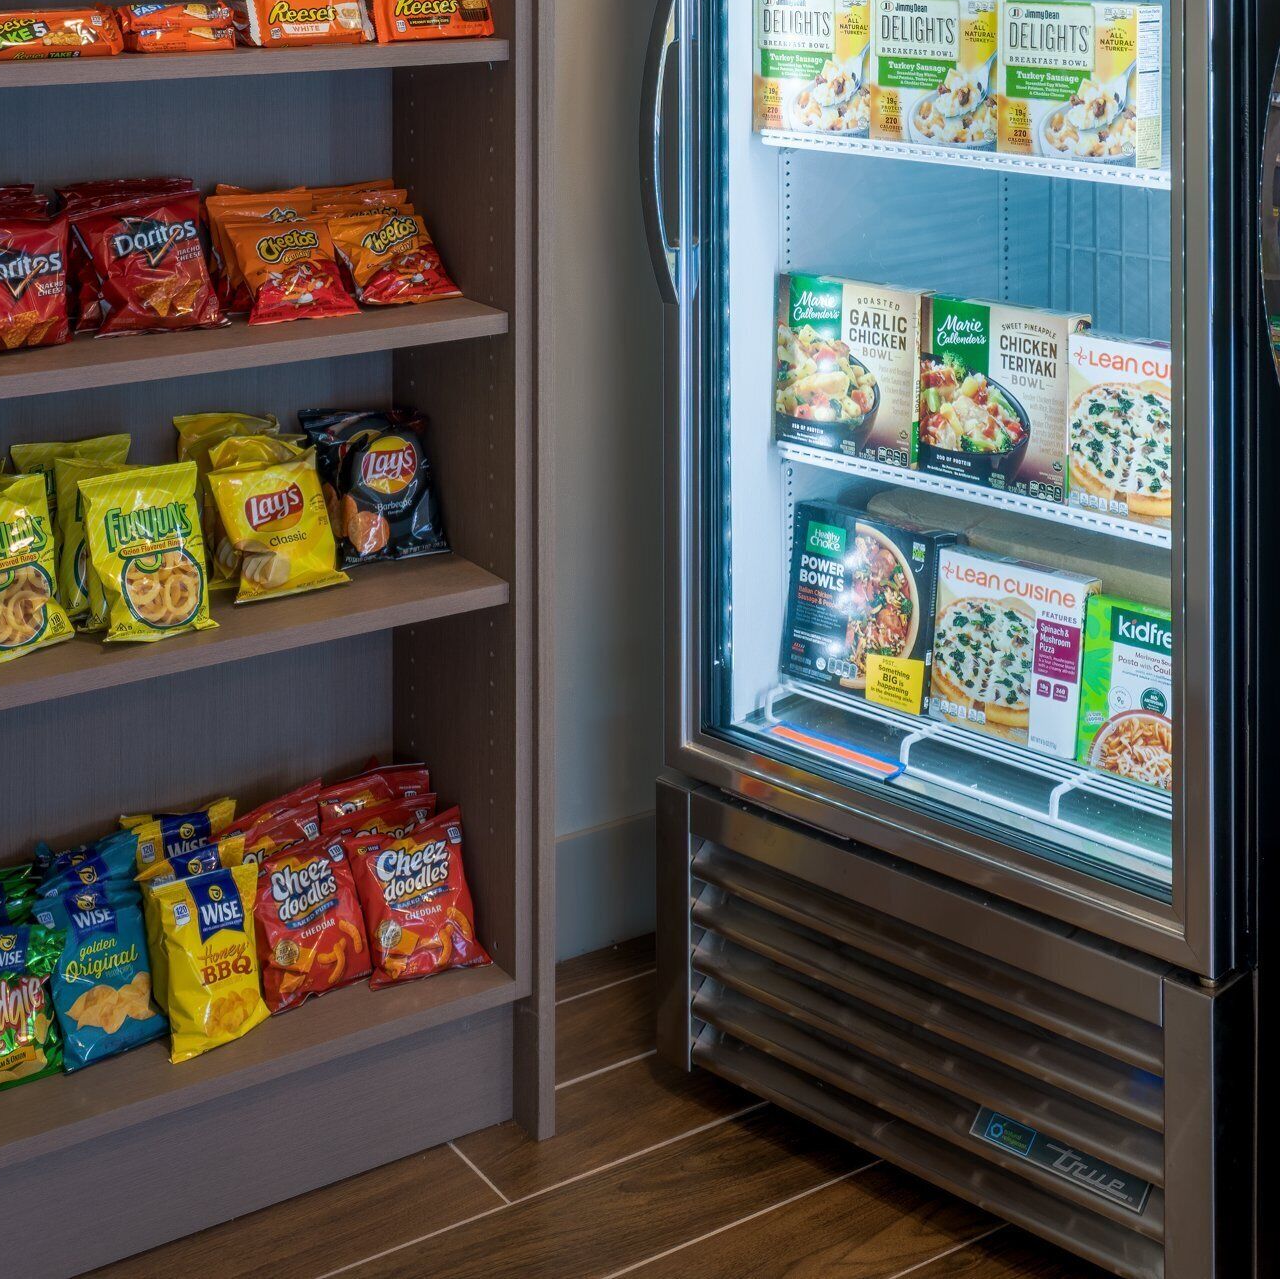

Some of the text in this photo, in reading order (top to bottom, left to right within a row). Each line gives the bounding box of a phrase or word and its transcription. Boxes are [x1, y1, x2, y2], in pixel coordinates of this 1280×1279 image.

[135, 4, 163, 16] FAST
[269, 0, 337, 24] Reese's
[32, 23, 47, 37] 5
[763, 9, 830, 37] DELIGHTS
[881, 15, 955, 44] DELIGHTS
[1009, 22, 1090, 54] DELIGHTS
[888, 60, 946, 73] Turkey Sausage
[1009, 56, 1088, 67] BREAKFAST BOWL
[1016, 70, 1080, 83] Turkey Sausage
[113, 221, 198, 257] Doritos
[256, 230, 319, 263] Cheetos
[362, 216, 418, 255] Cheetos
[857, 296, 901, 313] ROASTED
[849, 308, 908, 335] GARLIC
[937, 314, 983, 334] Marie
[1024, 323, 1057, 340] PINEAPPLE
[849, 327, 907, 352] CHICKEN
[999, 334, 1058, 360] CHICKEN
[1000, 353, 1057, 379] TERIYAKI
[1089, 350, 1138, 375] Lean
[1011, 373, 1046, 391] BOWL
[363, 442, 416, 487] Lay's
[250, 483, 303, 528] Lay's
[140, 541, 166, 554] Flavored
[270, 530, 308, 548] Classic
[20, 552, 37, 564] Rings
[801, 554, 844, 578] POWER
[799, 568, 844, 592] BOWLS
[956, 564, 1000, 590] Lean
[1041, 610, 1078, 625] FEATURES
[1039, 634, 1071, 648] Mushroom
[1040, 623, 1065, 637] Spinach
[1039, 642, 1055, 654] Pizza
[1118, 655, 1139, 667] Pasta
[877, 680, 909, 696] happening
[882, 673, 898, 685] BIG
[447, 827, 461, 839] 110
[375, 838, 451, 882] Cheez
[271, 858, 333, 904] Cheez
[384, 860, 450, 906] doodles
[277, 874, 338, 924] doodles
[39, 912, 53, 925] 120
[72, 908, 116, 930] WISE
[199, 901, 243, 928] WISE
[405, 903, 443, 921] CHEDDAR
[300, 917, 336, 940] CHEDDAR
[79, 937, 118, 962] golden
[198, 941, 250, 966] Honey
[64, 944, 140, 985] Original
[200, 954, 254, 988] BBQ
[10, 1050, 27, 1066] ONION
